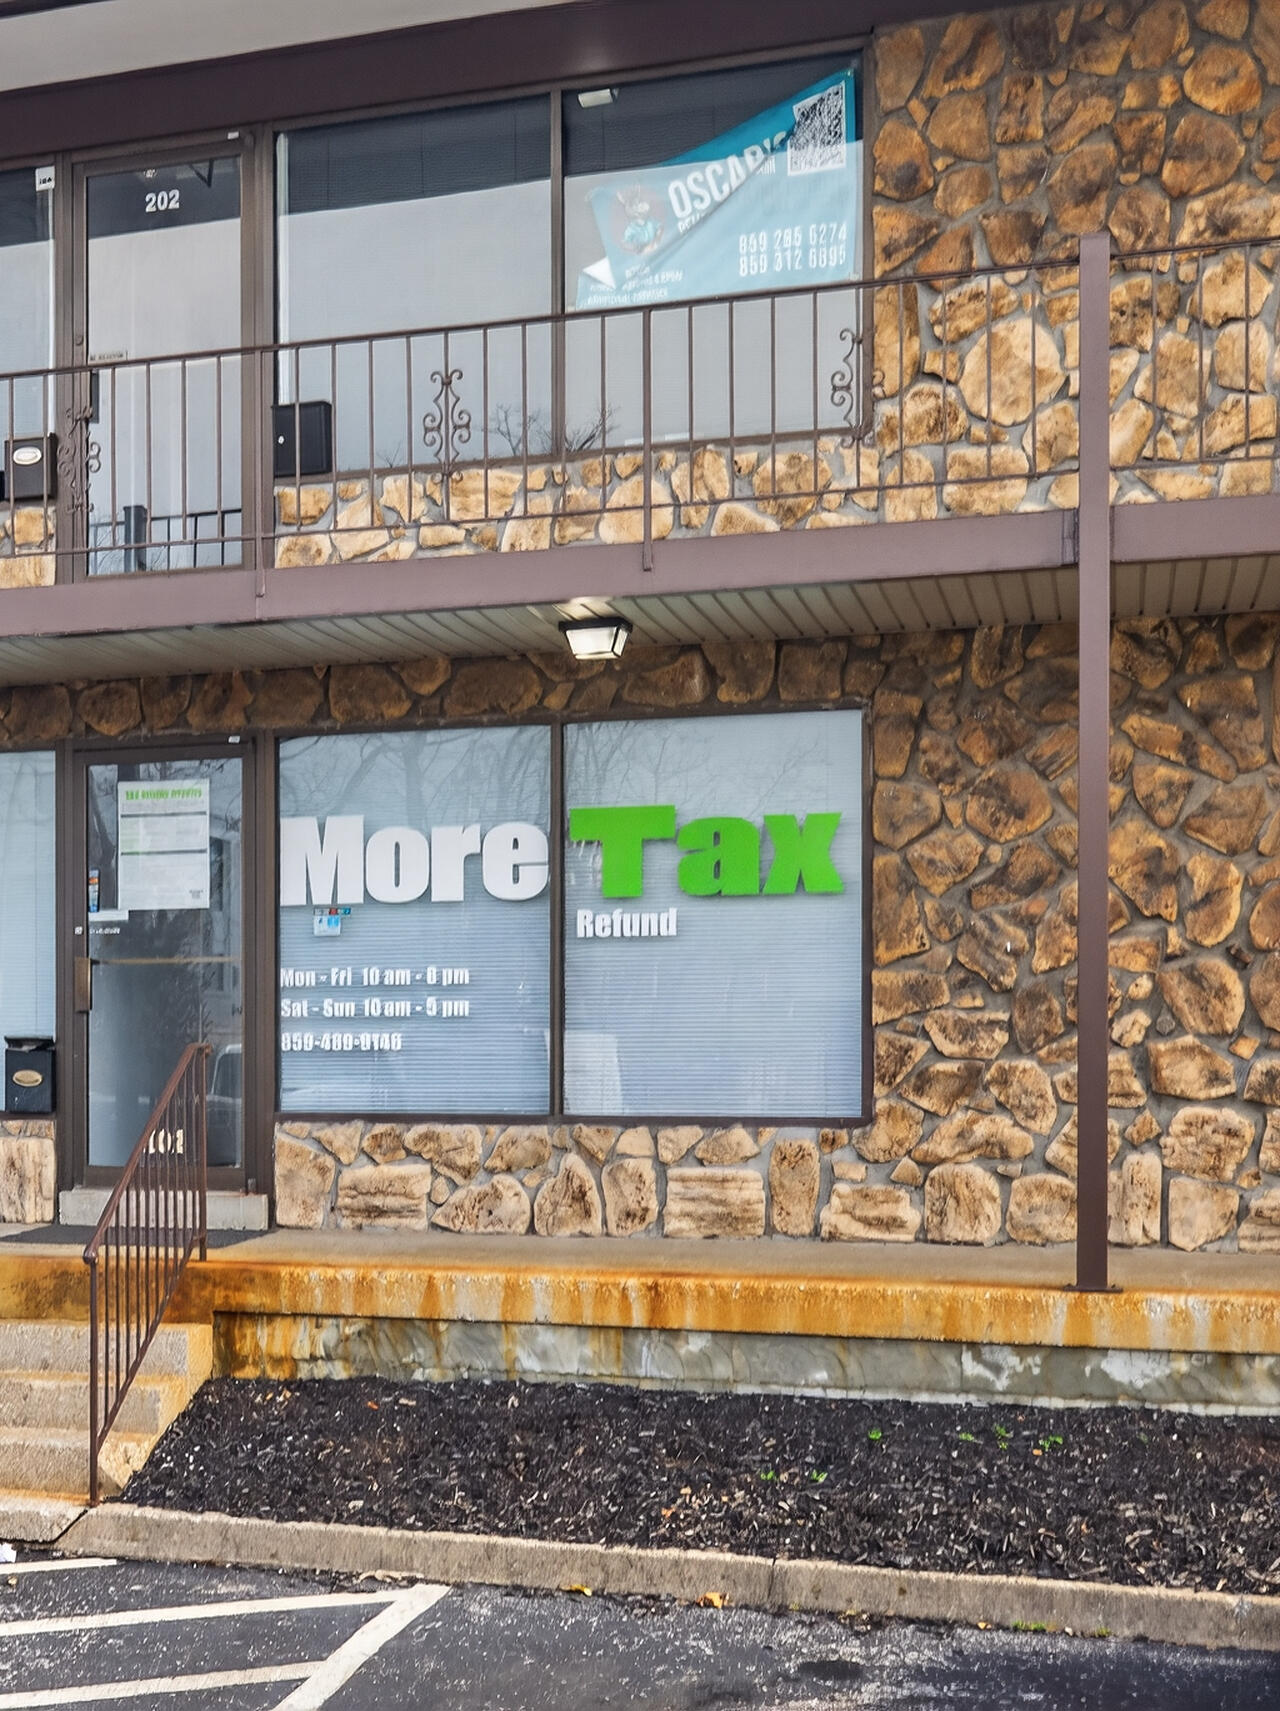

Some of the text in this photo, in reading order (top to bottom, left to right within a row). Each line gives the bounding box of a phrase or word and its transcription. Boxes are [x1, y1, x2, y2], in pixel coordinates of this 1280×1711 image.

[145, 189, 180, 213] 202
[280, 804, 845, 906] More Tax
[576, 907, 678, 939] Refund
[280, 968, 316, 988] Mon
[330, 966, 352, 986] Fri
[442, 967, 470, 986] pm
[280, 998, 309, 1018] Sat
[323, 998, 355, 1018] Sun
[441, 999, 470, 1018] pm
